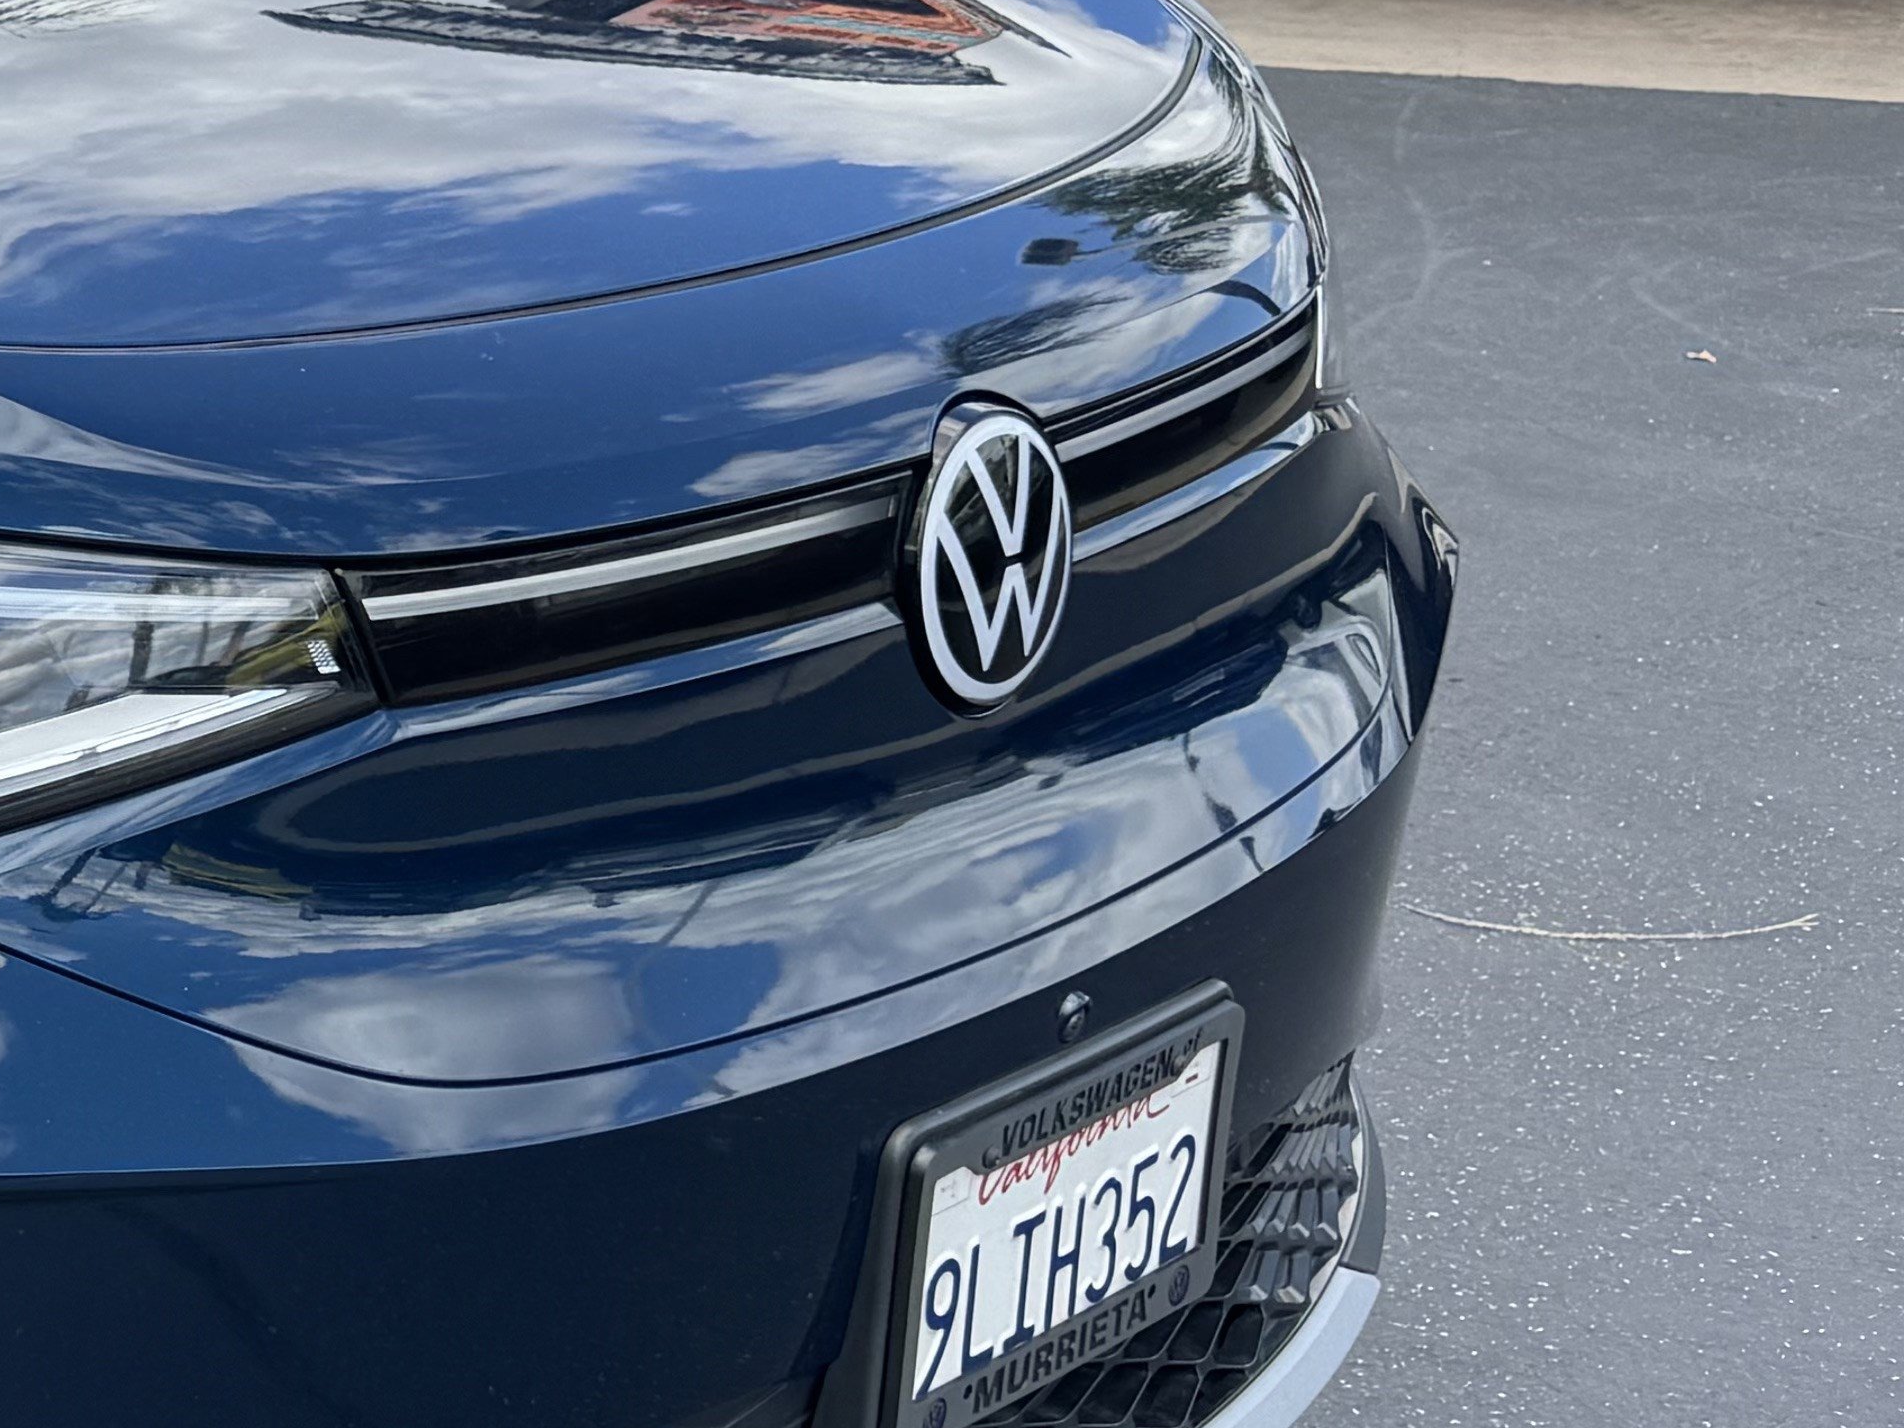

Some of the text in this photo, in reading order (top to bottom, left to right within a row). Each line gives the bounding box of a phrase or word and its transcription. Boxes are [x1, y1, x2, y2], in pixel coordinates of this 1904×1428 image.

[1001, 1045, 1176, 1157] VOLKSWAGEN
[913, 1133, 1197, 1403] 9LIH352
[971, 1289, 1148, 1414] MURRIETA
